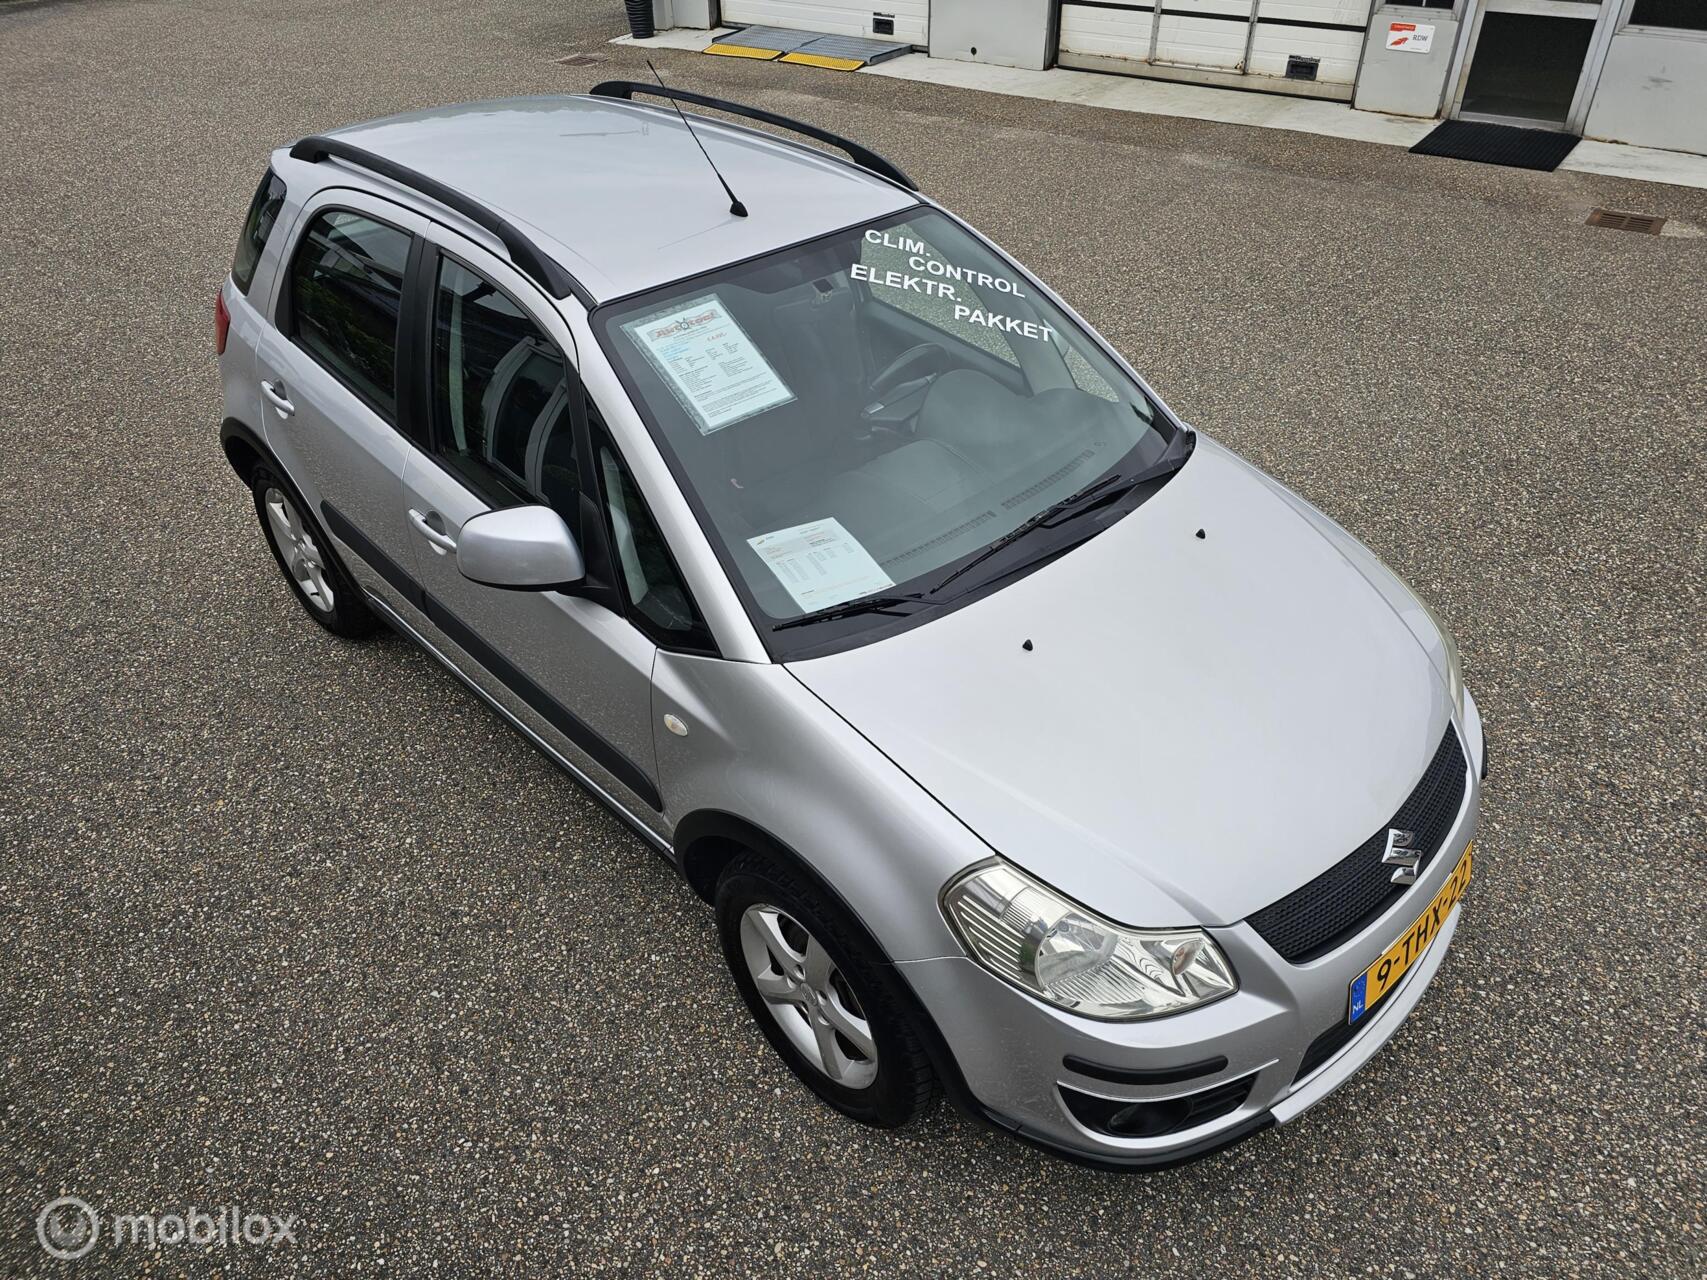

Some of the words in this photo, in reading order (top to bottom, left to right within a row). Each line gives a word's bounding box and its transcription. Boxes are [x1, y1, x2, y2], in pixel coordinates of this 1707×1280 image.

[864, 229, 931, 256] CLIM.
[850, 263, 962, 302] ELEKTR.
[908, 256, 1026, 298] CONTROL
[954, 304, 1052, 342] PAKKET
[1376, 859, 1467, 993] 9-THX-22
[1352, 1000, 1364, 1014] NL
